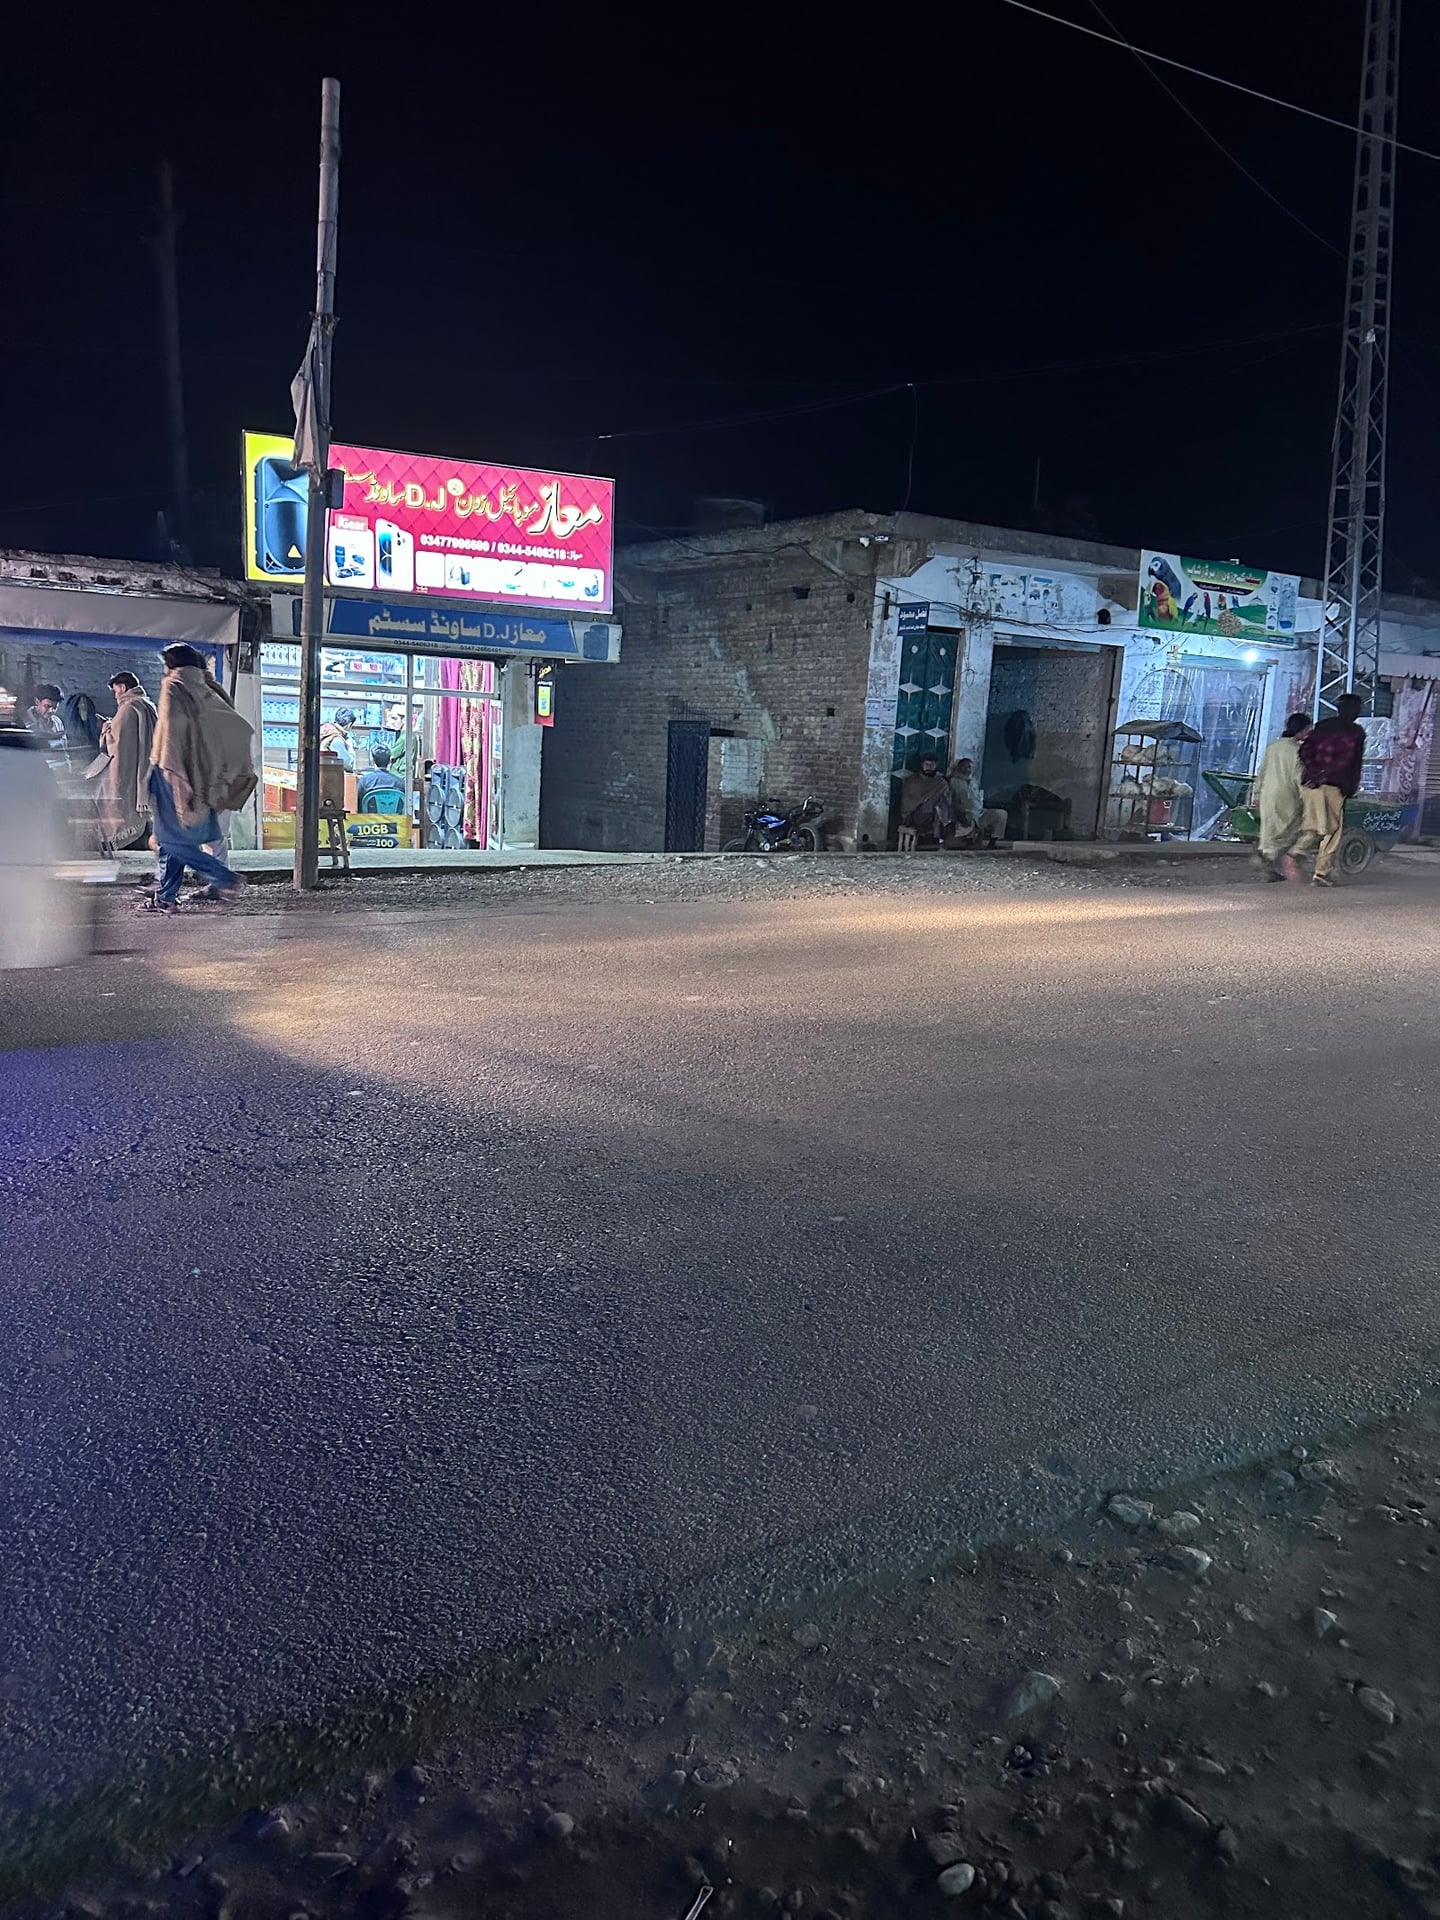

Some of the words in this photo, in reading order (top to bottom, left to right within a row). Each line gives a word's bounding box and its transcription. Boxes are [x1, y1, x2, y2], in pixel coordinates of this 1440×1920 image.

[405, 483, 445, 511] D.J
[528, 482, 603, 538] معاز
[368, 608, 426, 635] سسٹم
[430, 610, 481, 640] ساونڈ
[483, 622, 509, 640] D.J
[509, 622, 547, 645] معاز
[375, 838, 394, 848] 100
